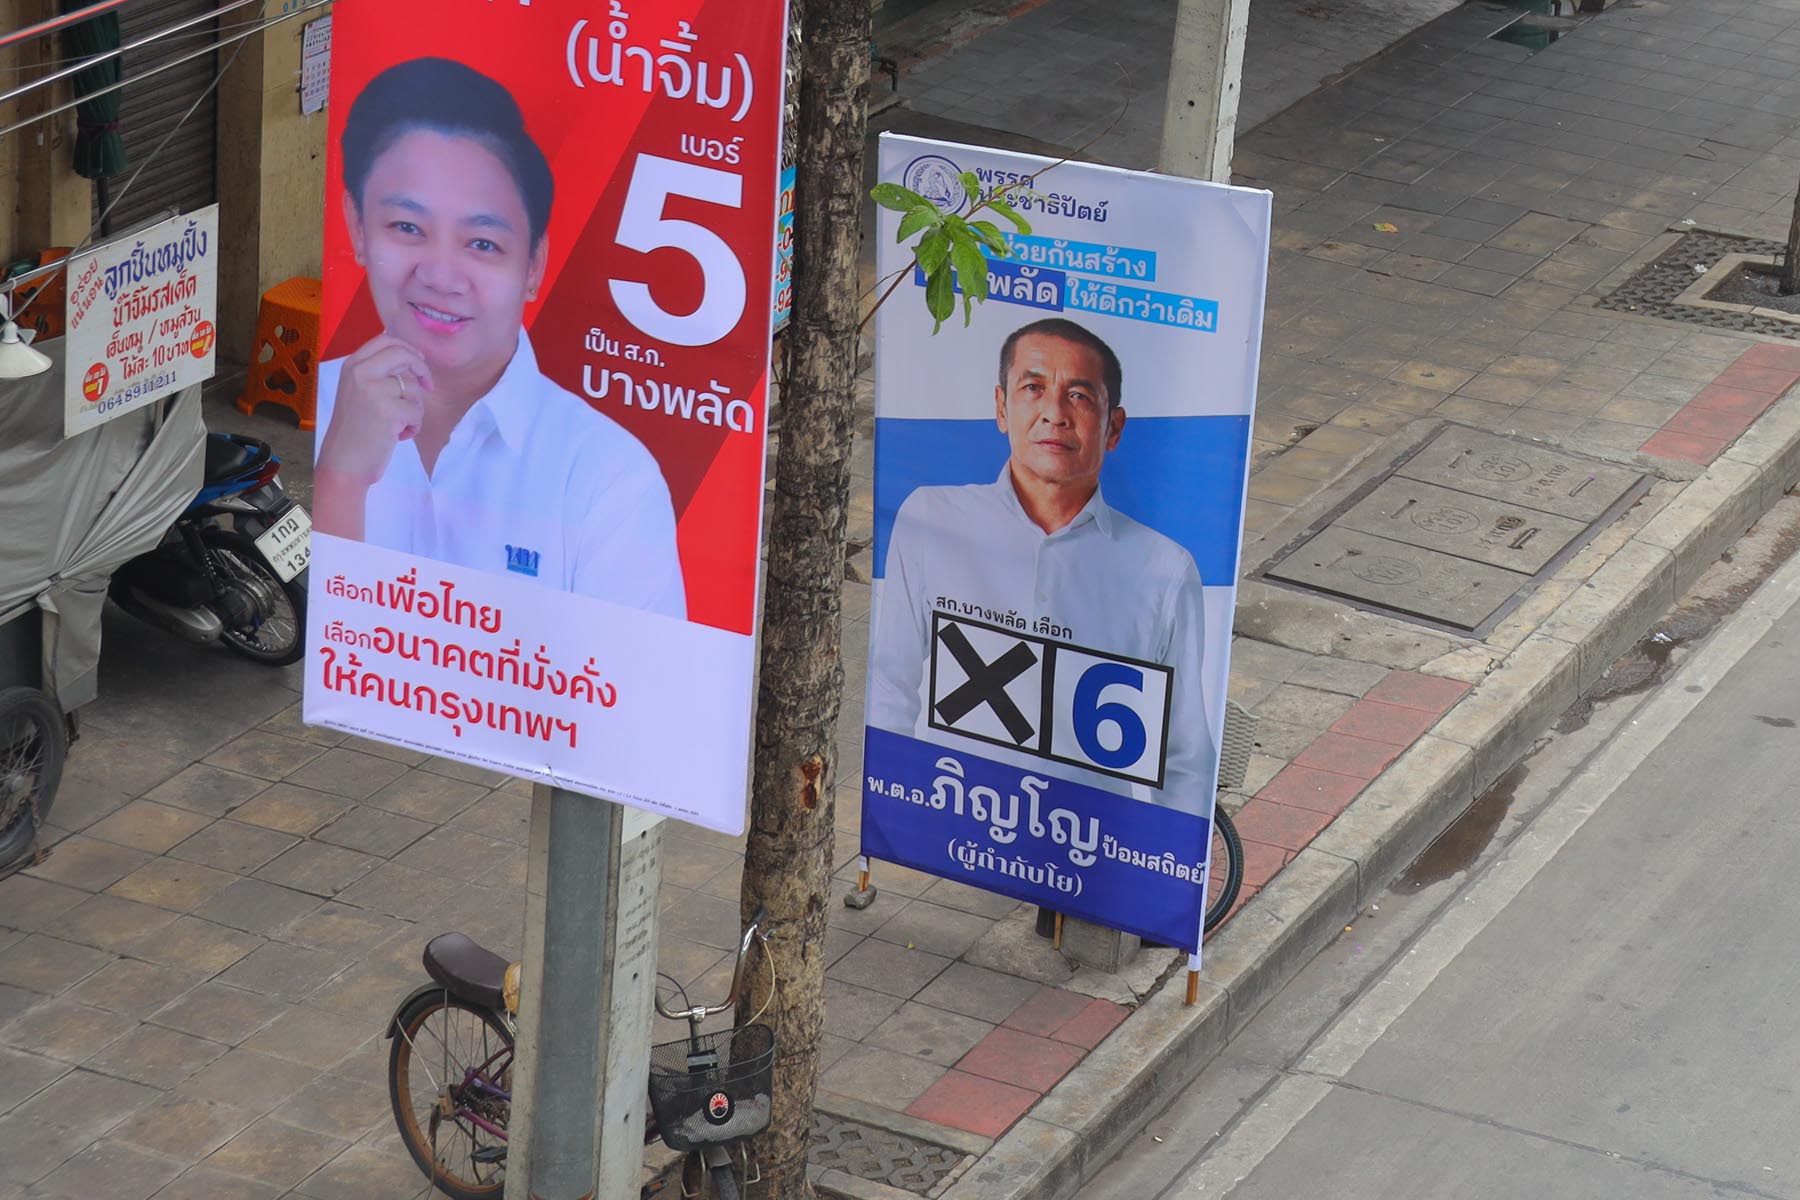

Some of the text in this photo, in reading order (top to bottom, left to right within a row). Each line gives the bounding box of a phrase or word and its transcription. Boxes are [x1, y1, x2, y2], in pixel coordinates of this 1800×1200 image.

[566, 0, 754, 122] (น้ำจิ้ม)
[680, 132, 744, 164] เบอร์
[976, 166, 1034, 189] พรรค
[104, 220, 208, 300] ลูกชิ้นหมูปิ้ง
[607, 152, 748, 347] 5
[112, 268, 198, 328] น้ำจิ้มรสเด็ด
[159, 305, 201, 339] หมูล้วน
[1066, 277, 1212, 330] ให้ดีกว่าเดิม
[120, 356, 150, 381] ไม้ละ
[153, 350, 165, 368] 10
[166, 339, 190, 362] บาท
[584, 328, 666, 368] เป็น ส.ก.
[582, 364, 755, 434] บางพลัด
[1032, 614, 1073, 640] เลือก
[319, 647, 578, 749] ให้คนกรุงเทพฯ
[1072, 663, 1147, 769] 6
[947, 837, 1084, 898] (ผู้กำกับโย)
